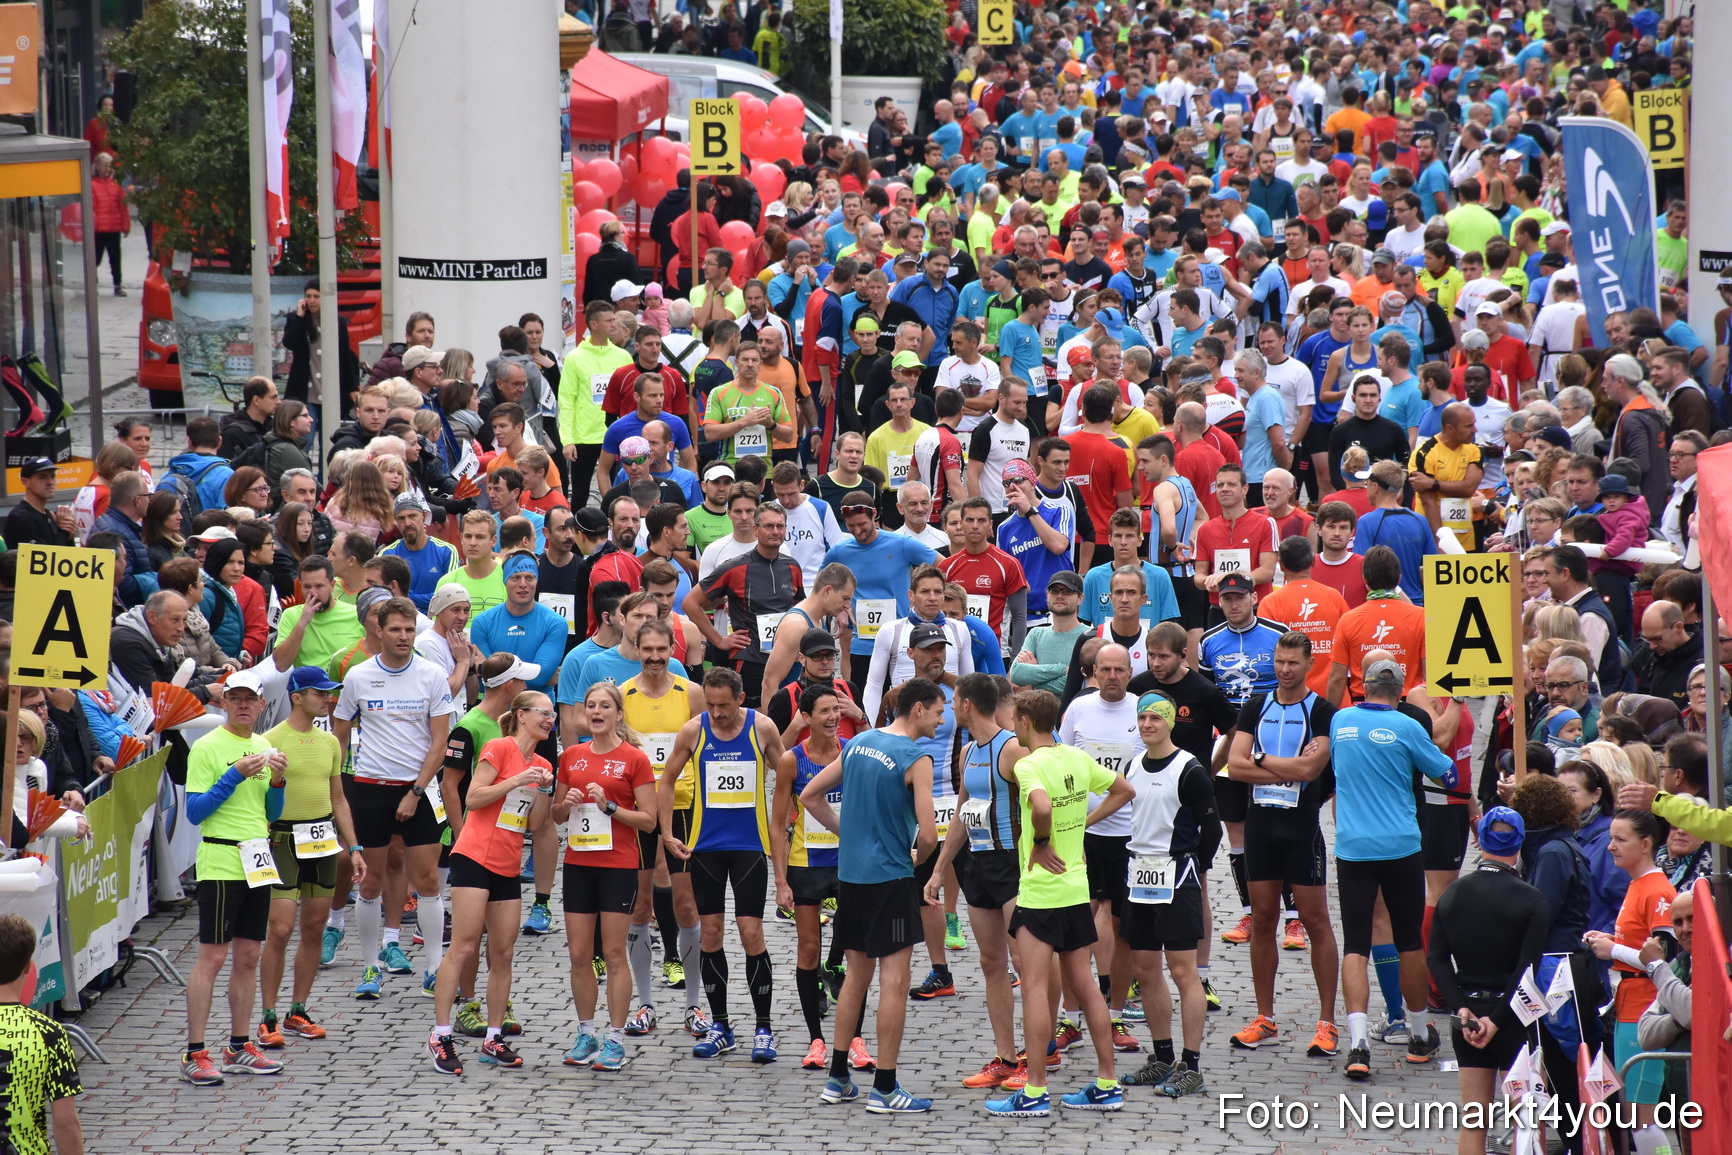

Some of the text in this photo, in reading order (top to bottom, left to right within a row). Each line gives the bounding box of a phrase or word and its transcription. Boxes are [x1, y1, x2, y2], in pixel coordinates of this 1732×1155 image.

[987, 8, 1004, 33] C
[695, 102, 734, 116] Block
[1640, 95, 1681, 110] Block
[703, 121, 728, 158] B
[1649, 115, 1676, 151] B
[400, 261, 542, 279] www.MINI-Partl.de
[1590, 227, 1627, 315] ONE
[739, 435, 763, 447] 2721
[55, 475, 78, 485] analyse
[1450, 508, 1467, 520] 282
[29, 550, 105, 580] Block
[1219, 561, 1240, 571] 402
[1435, 559, 1510, 585] Block
[32, 589, 88, 659] A
[867, 611, 883, 624] 97
[1446, 596, 1503, 665] A
[656, 748, 665, 763] 5
[855, 746, 897, 771] PAVELSBACH
[716, 775, 745, 791] 293
[1262, 790, 1285, 798] Wolfgang
[310, 825, 325, 840] 65
[581, 818, 591, 833] 3
[807, 833, 836, 843] Christine
[1136, 869, 1165, 886] 2001
